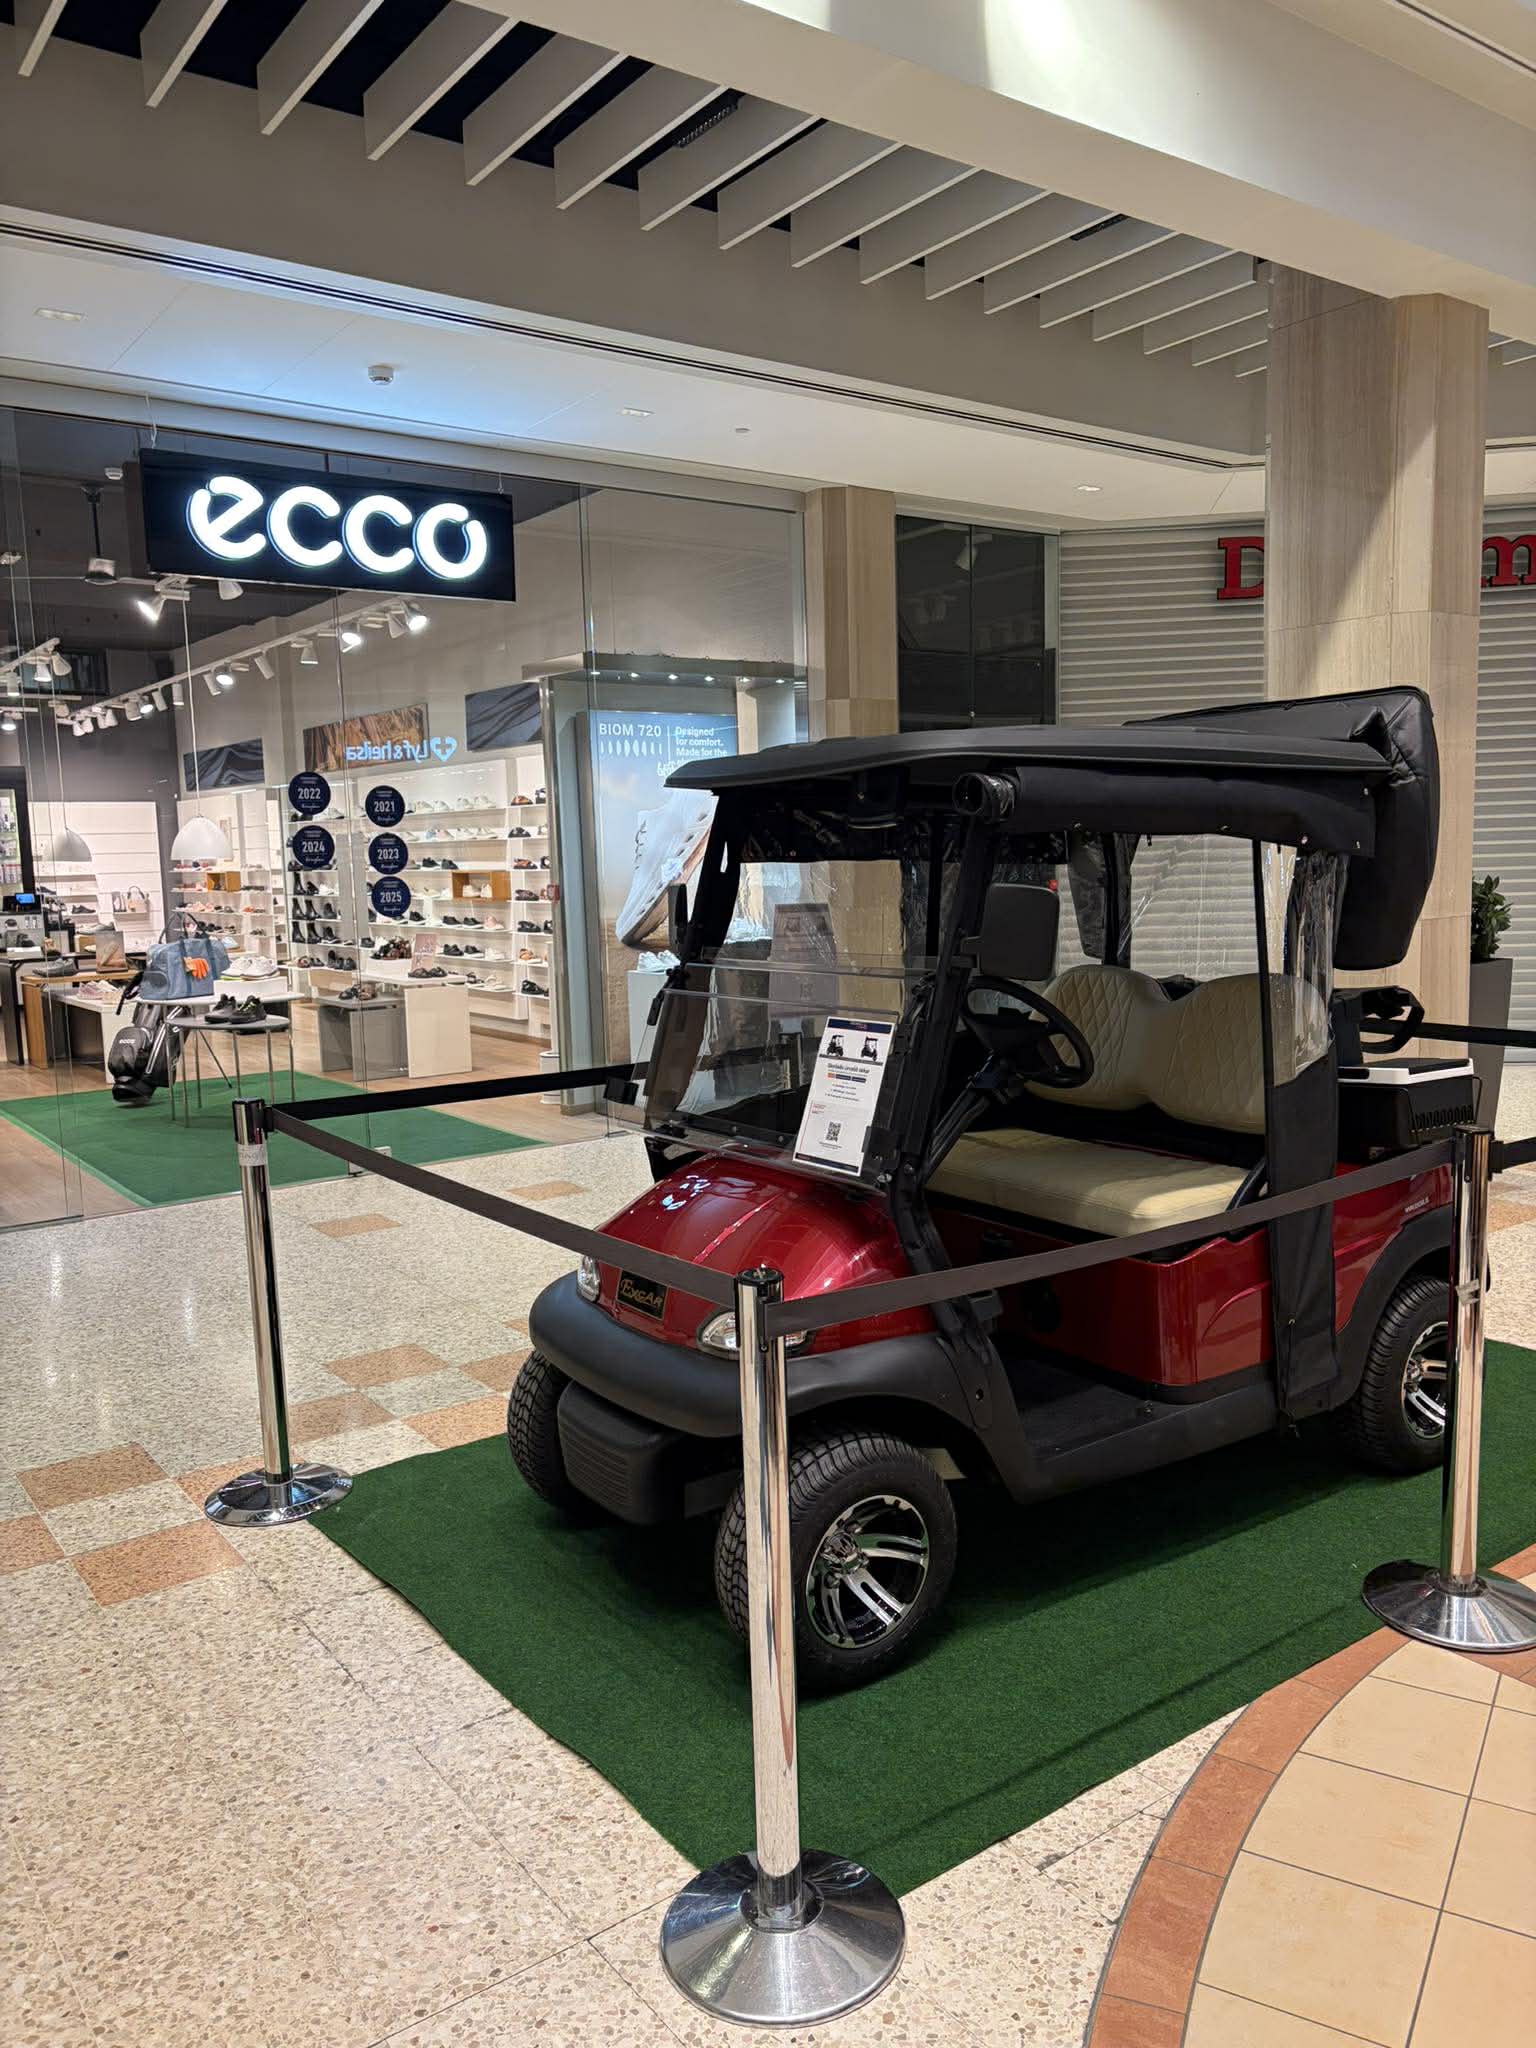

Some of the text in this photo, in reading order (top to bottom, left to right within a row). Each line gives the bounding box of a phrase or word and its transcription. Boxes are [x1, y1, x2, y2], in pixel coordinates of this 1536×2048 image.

[186, 475, 488, 579] ecco
[600, 723, 662, 737] BIOM 720
[675, 726, 714, 738] Designed
[676, 747, 700, 757] Made
[701, 747, 713, 758] for
[297, 788, 321, 800] 2022
[373, 801, 395, 813] 2021
[302, 841, 326, 853] 2024
[377, 849, 399, 860] 2023
[380, 892, 402, 903] 2025
